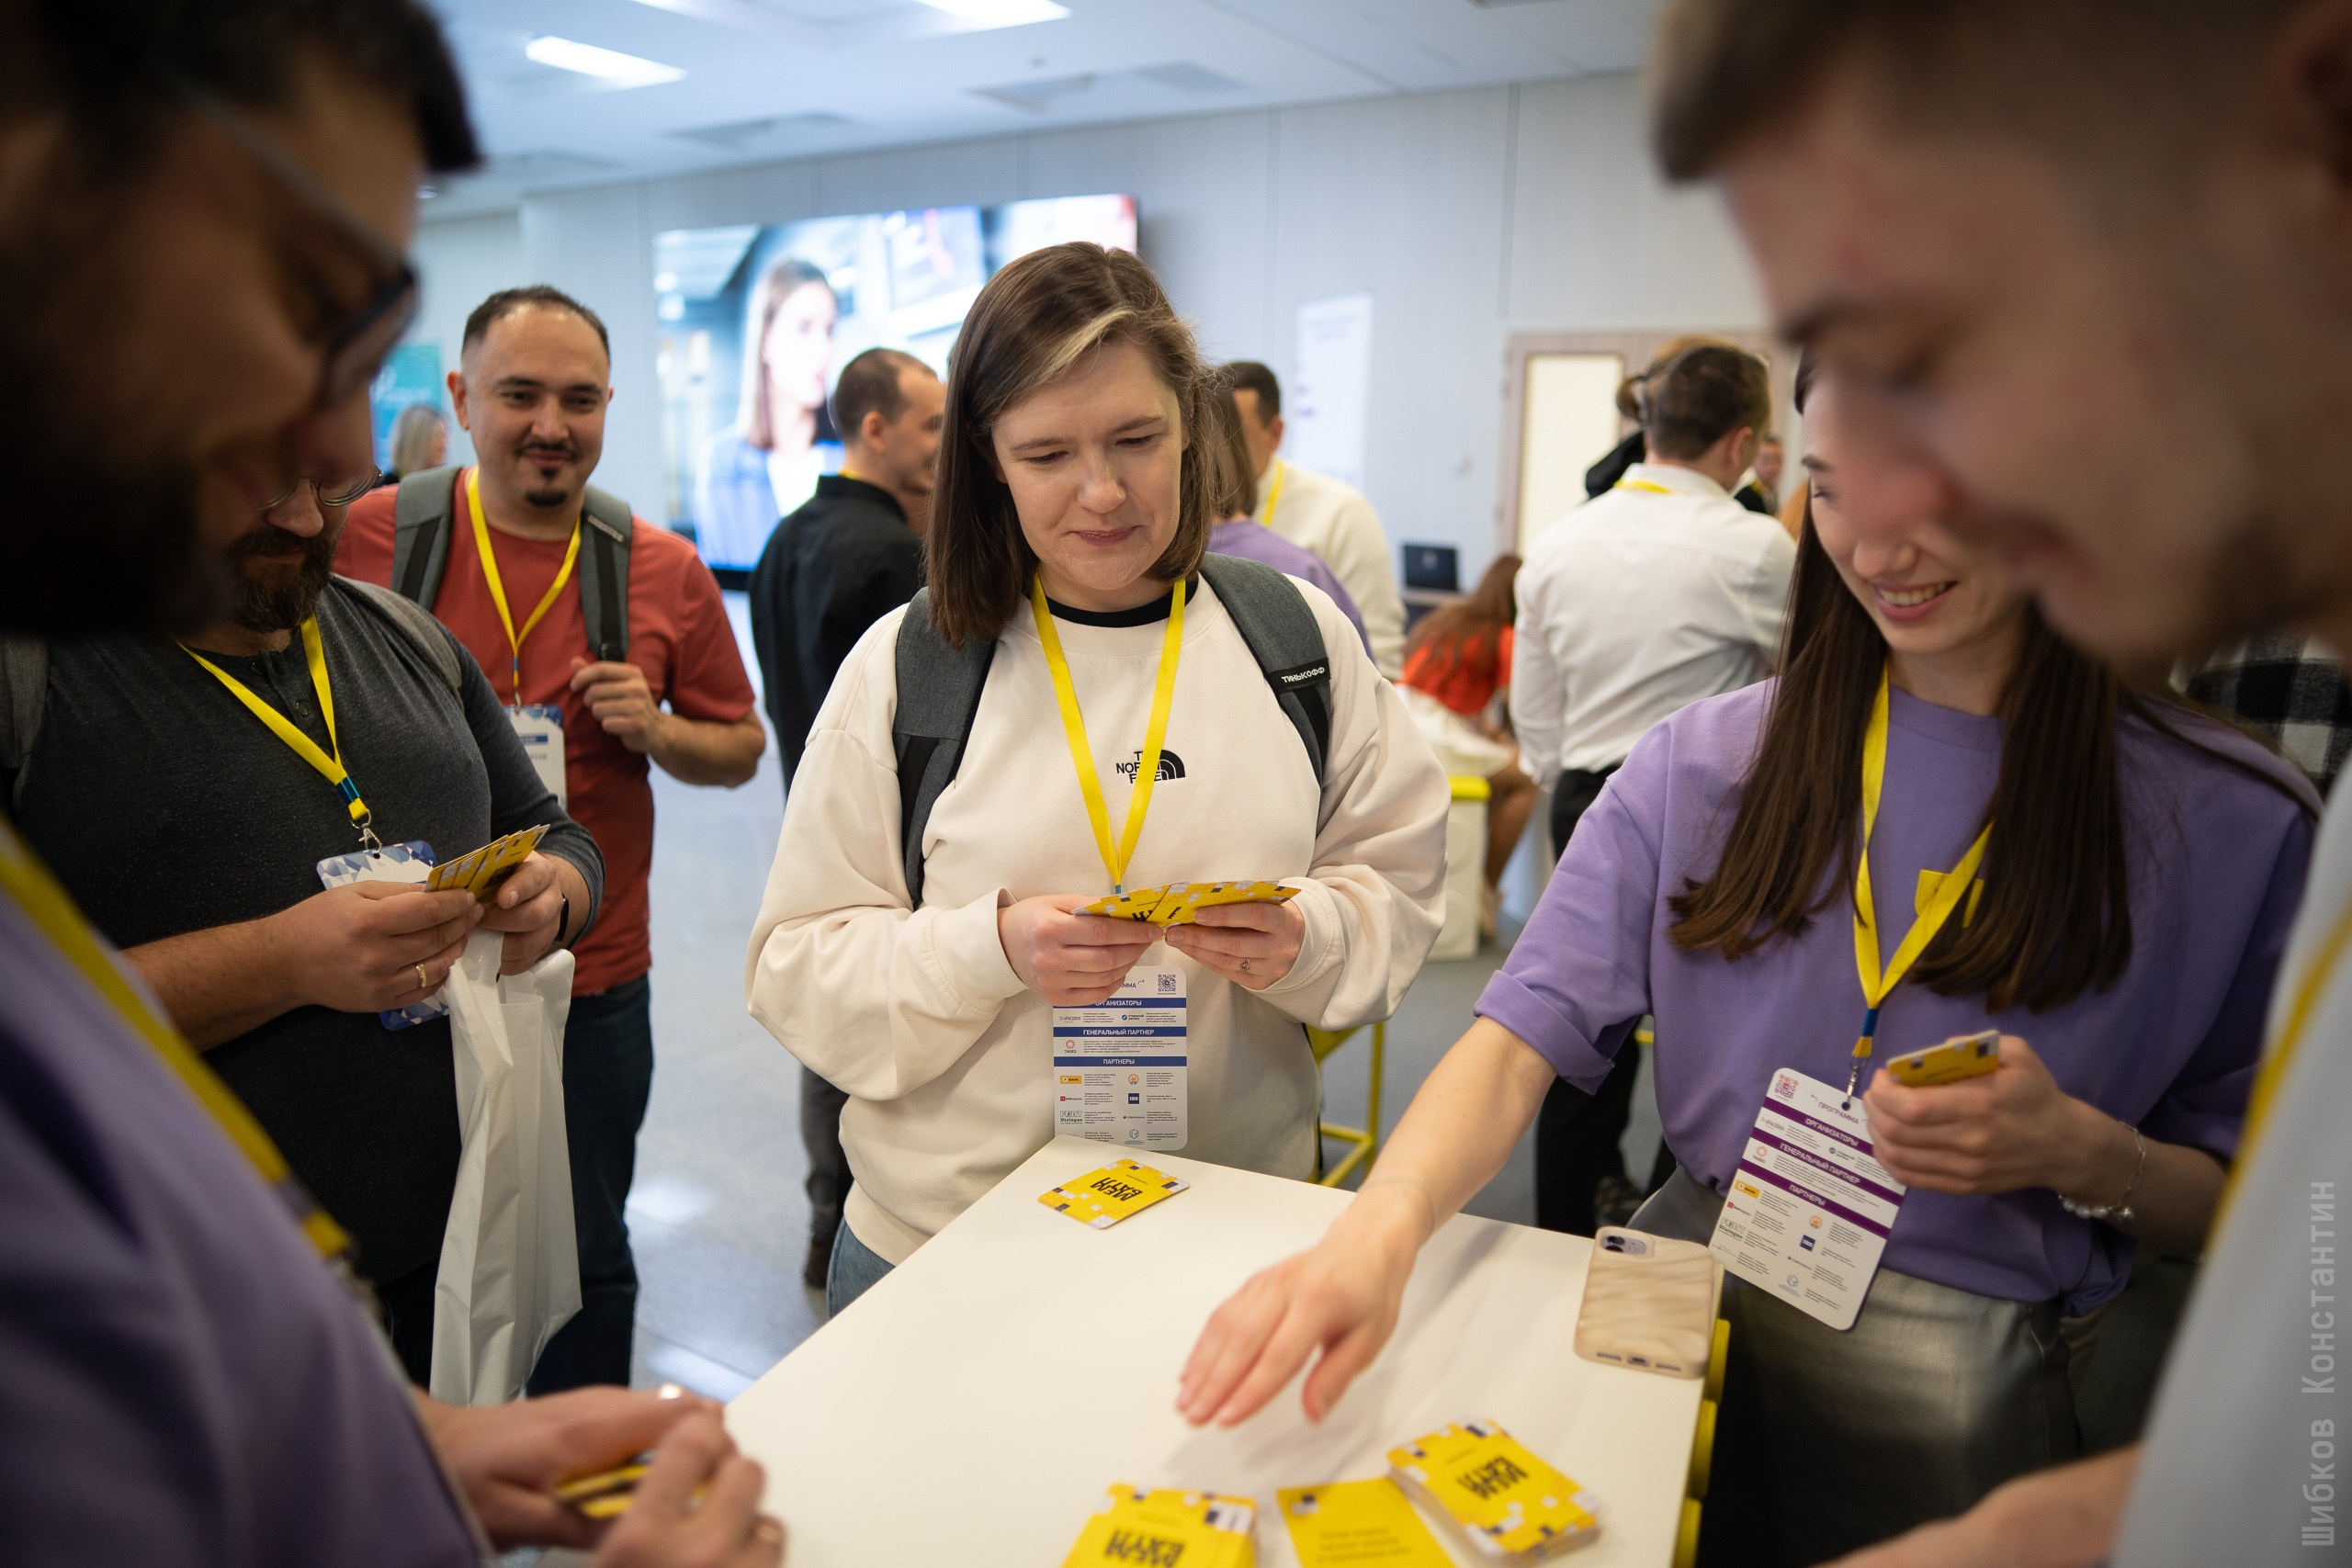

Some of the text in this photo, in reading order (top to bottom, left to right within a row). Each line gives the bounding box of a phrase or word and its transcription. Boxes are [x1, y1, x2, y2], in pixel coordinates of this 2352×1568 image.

[1281, 666, 1325, 683] ТИНЬКОФФ
[1116, 761, 1160, 774] NOR
[1129, 771, 1162, 784] FE
[1804, 1117, 1859, 1147] ОРГАНИЗАТОРЫ
[1780, 1142, 1829, 1171] ГЕНЕРАЛЬНЫЙ
[1828, 1164, 1861, 1184] ПАРТНЕР
[1789, 1183, 1826, 1206] ПАРТНЕРЫ
